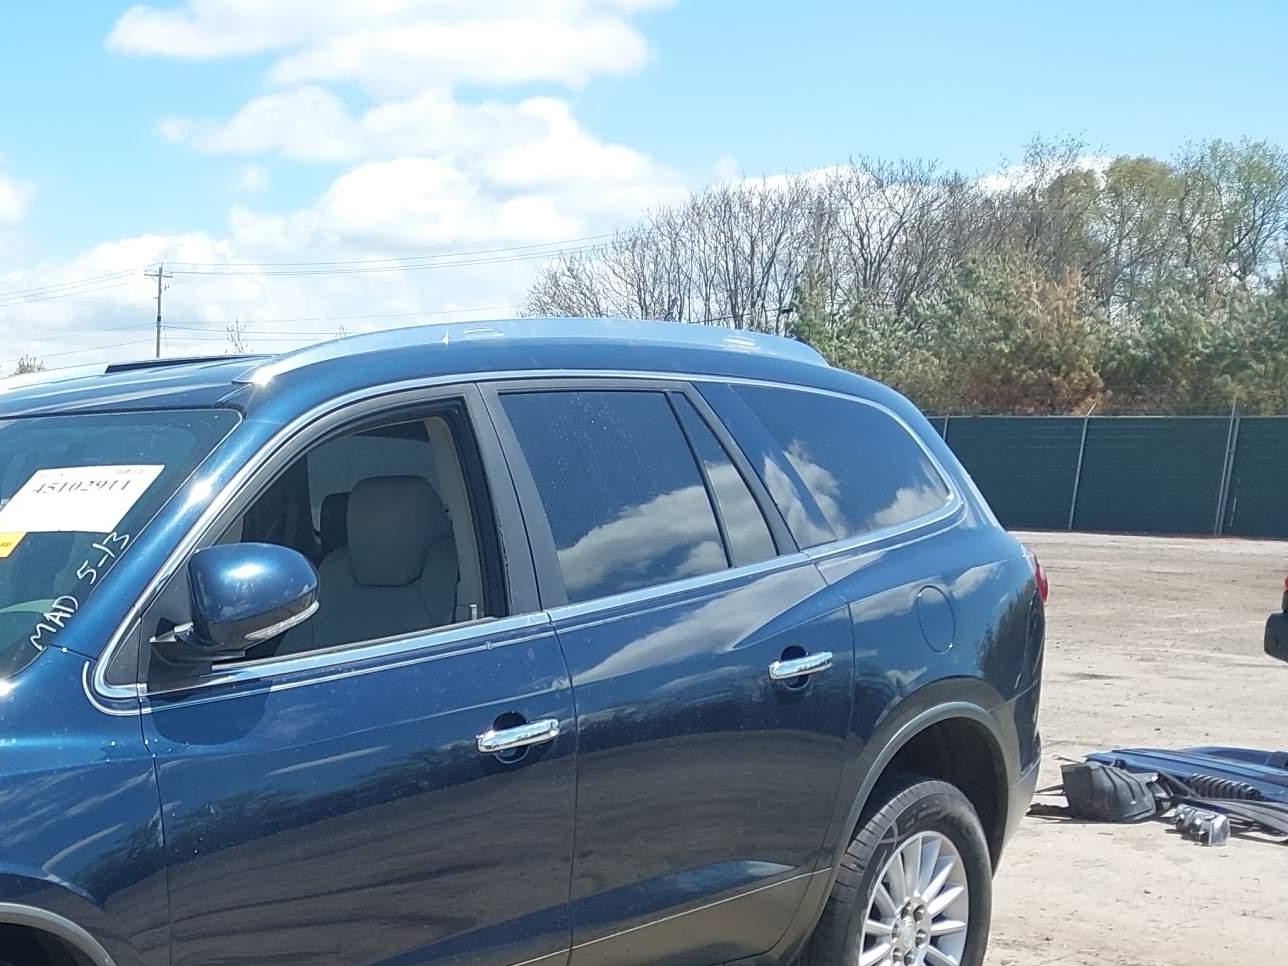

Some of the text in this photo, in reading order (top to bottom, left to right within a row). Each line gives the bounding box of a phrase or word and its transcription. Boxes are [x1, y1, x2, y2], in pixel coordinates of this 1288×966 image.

[32, 478, 132, 495] 45102911
[29, 595, 79, 651] MAD
[76, 531, 130, 584] 5-13
